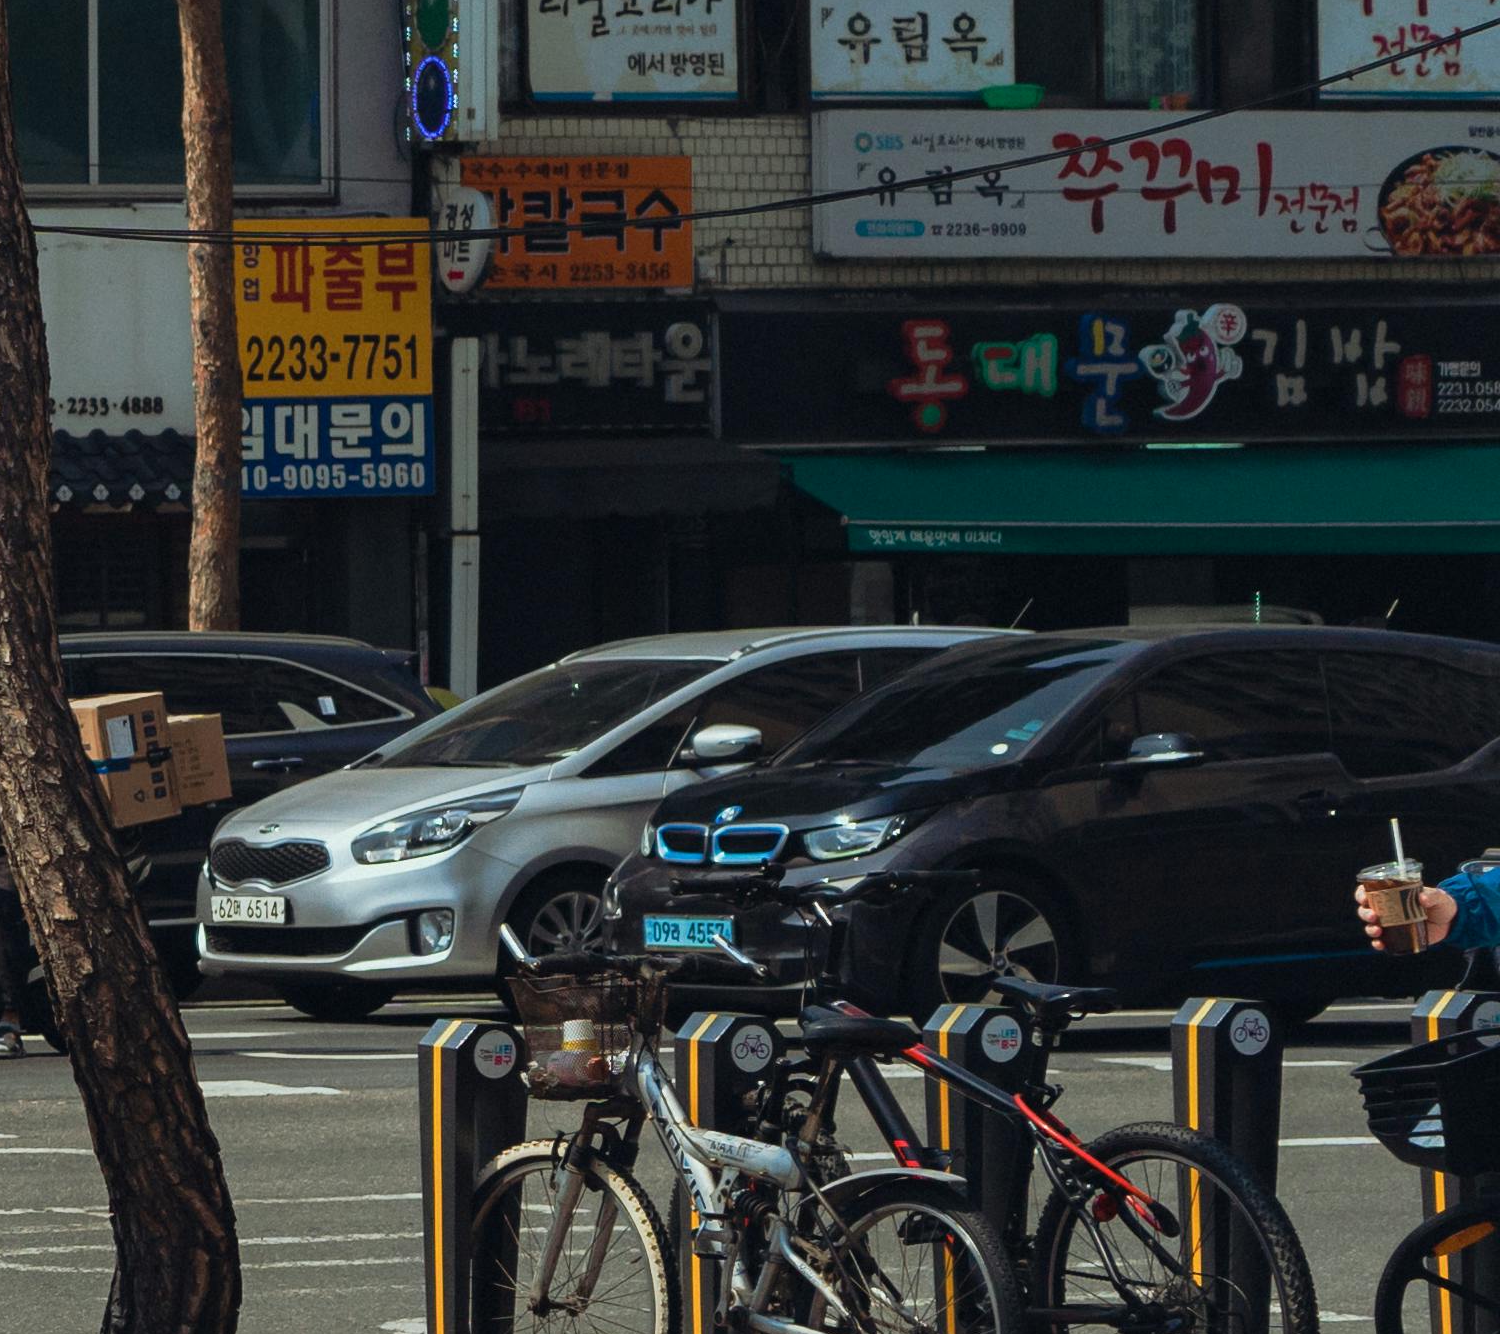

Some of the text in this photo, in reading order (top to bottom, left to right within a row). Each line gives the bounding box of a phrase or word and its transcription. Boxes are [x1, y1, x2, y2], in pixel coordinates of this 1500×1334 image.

[628, 52, 725, 77] 에서 방영된
[839, 11, 987, 65] 유림옥
[1373, 23, 1462, 77] 전문점
[1052, 133, 1360, 234] 쭈꾸미 전문점
[271, 239, 419, 313] 파출부
[246, 334, 418, 382] 2233-7751
[888, 313, 1401, 432] 동대문 김밥
[247, 899, 278, 919] 6514
